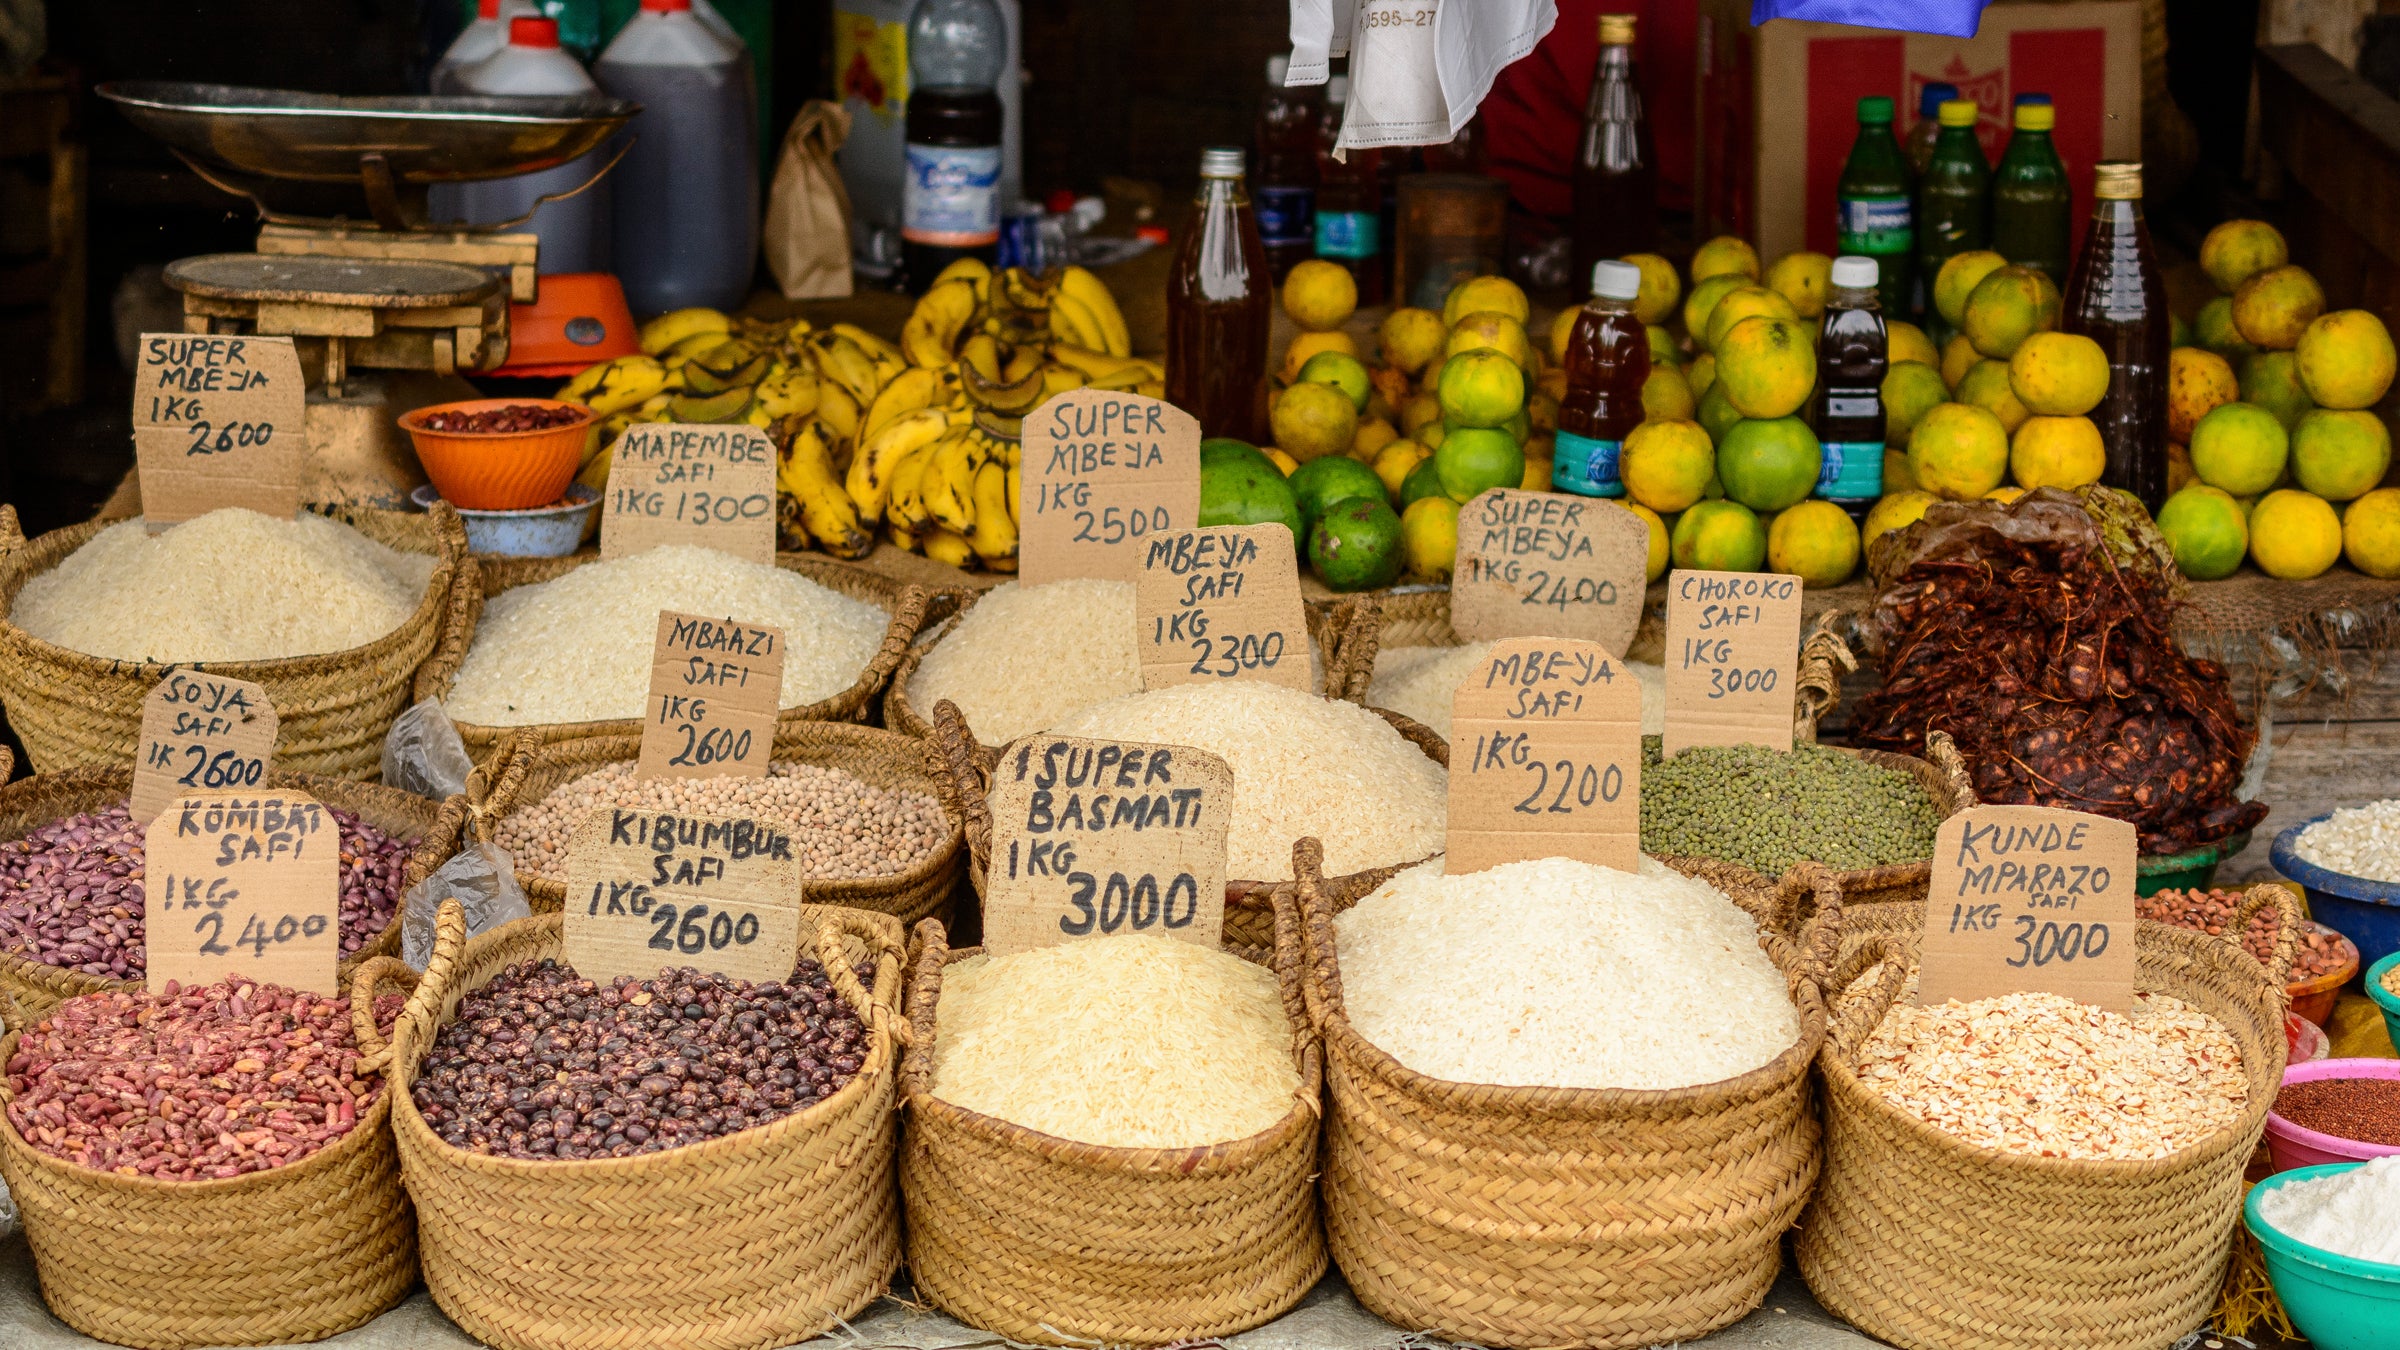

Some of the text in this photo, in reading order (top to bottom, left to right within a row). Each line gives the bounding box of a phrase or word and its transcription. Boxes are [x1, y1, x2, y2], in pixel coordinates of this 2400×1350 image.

[147, 338, 246, 368] SUPER
[151, 395, 204, 423] 1KG
[1049, 400, 1166, 441] SUPER
[186, 420, 274, 456] 2600
[622, 431, 768, 463] MAPEMBE
[655, 461, 714, 484] SAFI
[616, 488, 771, 526] 1KG 1300
[1037, 482, 1092, 514] 1KG
[1481, 492, 1585, 527] SUPER
[1072, 505, 1170, 544] 2500
[1146, 532, 1261, 575] MBEYA
[1481, 526, 1593, 561] MBEYA
[1180, 571, 1244, 607] SAFI
[1472, 558, 1618, 613] 1KG 2400
[1681, 577, 1794, 603] CHOROKO
[1154, 608, 1210, 646] 1KG
[1698, 604, 1760, 630] SAFI
[667, 617, 774, 657] MBAAZI
[1190, 631, 1285, 678] 2300
[1683, 637, 1732, 670] 1KG
[683, 656, 749, 687] SAFI
[1485, 651, 1615, 689] MBEYA
[1708, 668, 1778, 699] 3000
[163, 675, 253, 714] SOYA
[660, 694, 706, 724] 1KG
[1506, 688, 1583, 719] SAFI
[172, 712, 232, 737] SAFI
[669, 723, 752, 767] 2600
[1472, 730, 1531, 773] 1KG
[178, 744, 263, 789] 2600
[1513, 760, 1622, 814] 2200
[178, 799, 321, 838] KOMBAT
[1027, 787, 1203, 833] BASMATI
[215, 832, 304, 867] SAFI
[610, 809, 793, 861] KIBUMBUR
[1957, 820, 2090, 867] KUNDE
[652, 855, 724, 887] SAFI
[1009, 838, 1078, 880] 1KG
[164, 873, 240, 910] 1KG
[1958, 861, 2111, 897] MPARAZO
[588, 880, 657, 916] 1KG
[1059, 871, 1198, 935] 3000
[2027, 892, 2077, 910] SAFI
[194, 911, 328, 958] 2400
[648, 903, 760, 955] 2600
[1949, 903, 2110, 968] 1KG 3000
